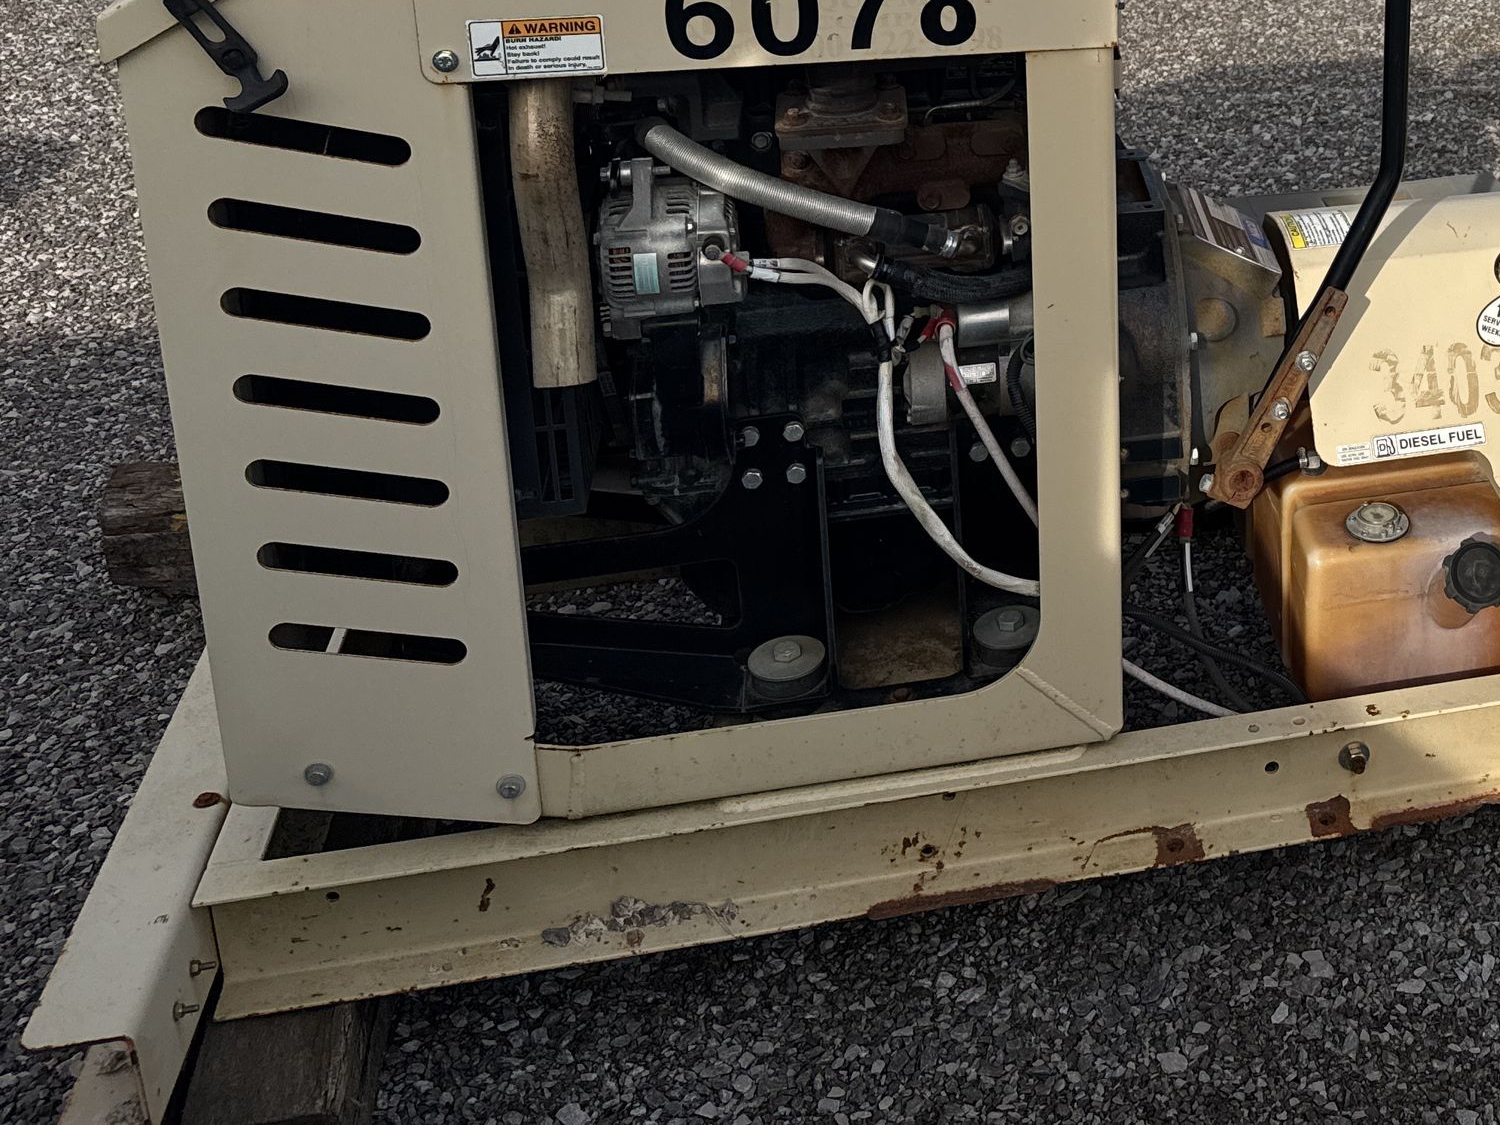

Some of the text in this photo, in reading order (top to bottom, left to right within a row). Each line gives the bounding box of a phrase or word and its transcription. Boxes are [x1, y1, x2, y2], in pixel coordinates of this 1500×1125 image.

[523, 20, 596, 34] WARNING
[1400, 428, 1482, 450] DIESEL FUEL
